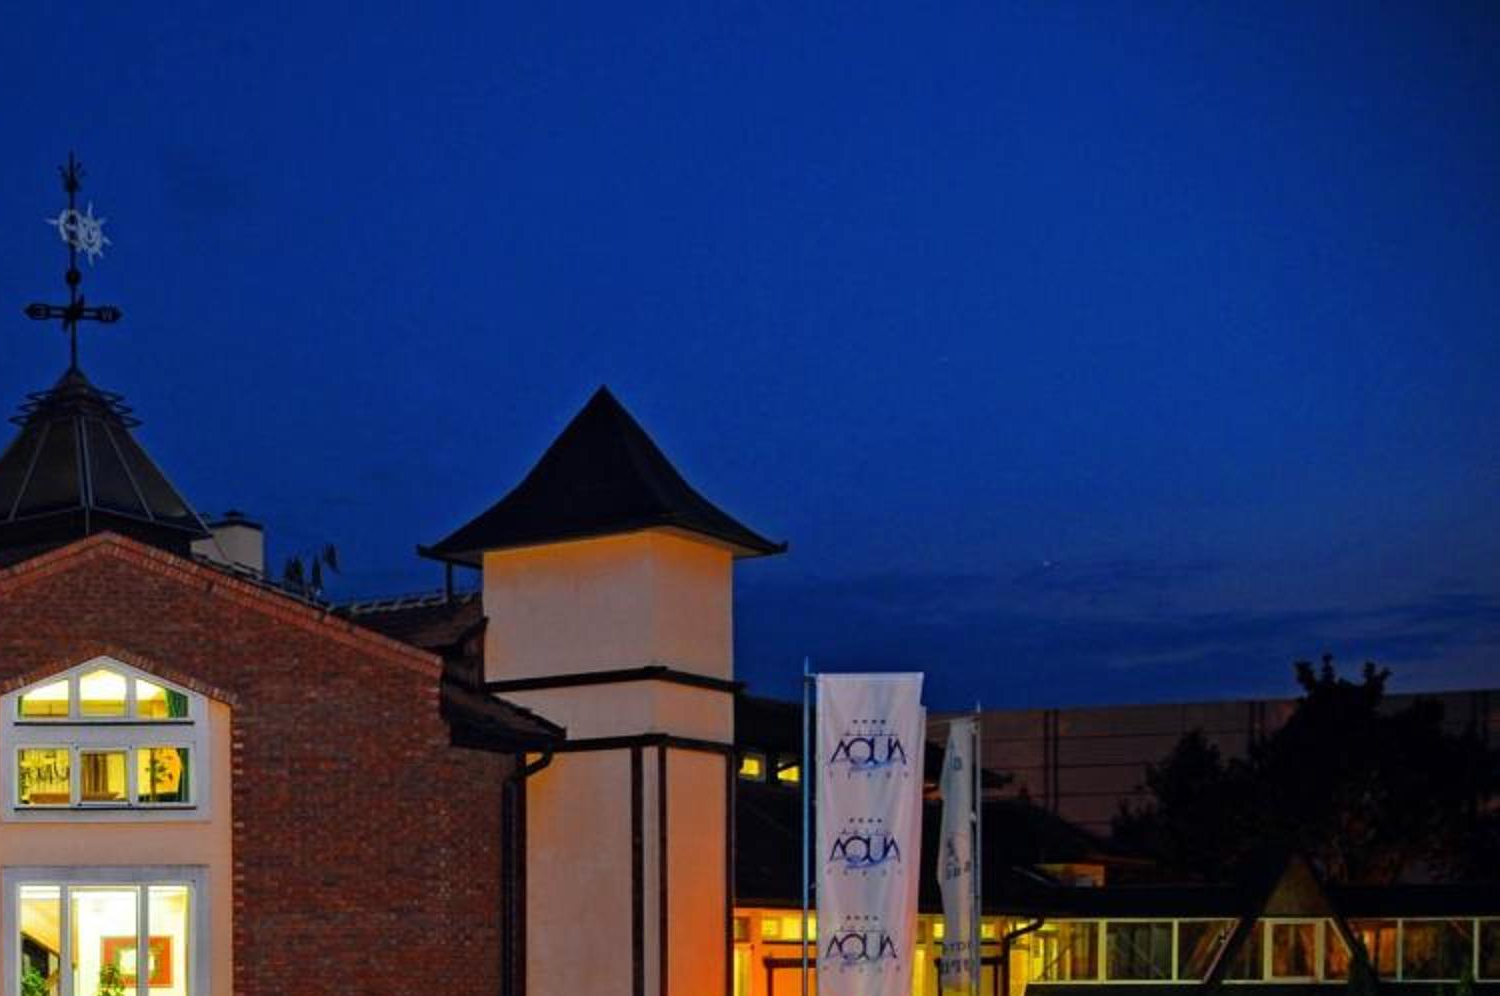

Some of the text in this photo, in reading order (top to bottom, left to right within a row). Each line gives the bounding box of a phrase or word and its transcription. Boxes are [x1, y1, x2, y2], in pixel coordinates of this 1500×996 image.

[830, 736, 907, 765] AQUA
[829, 835, 901, 864] AQUA
[826, 933, 898, 962] AQUA
